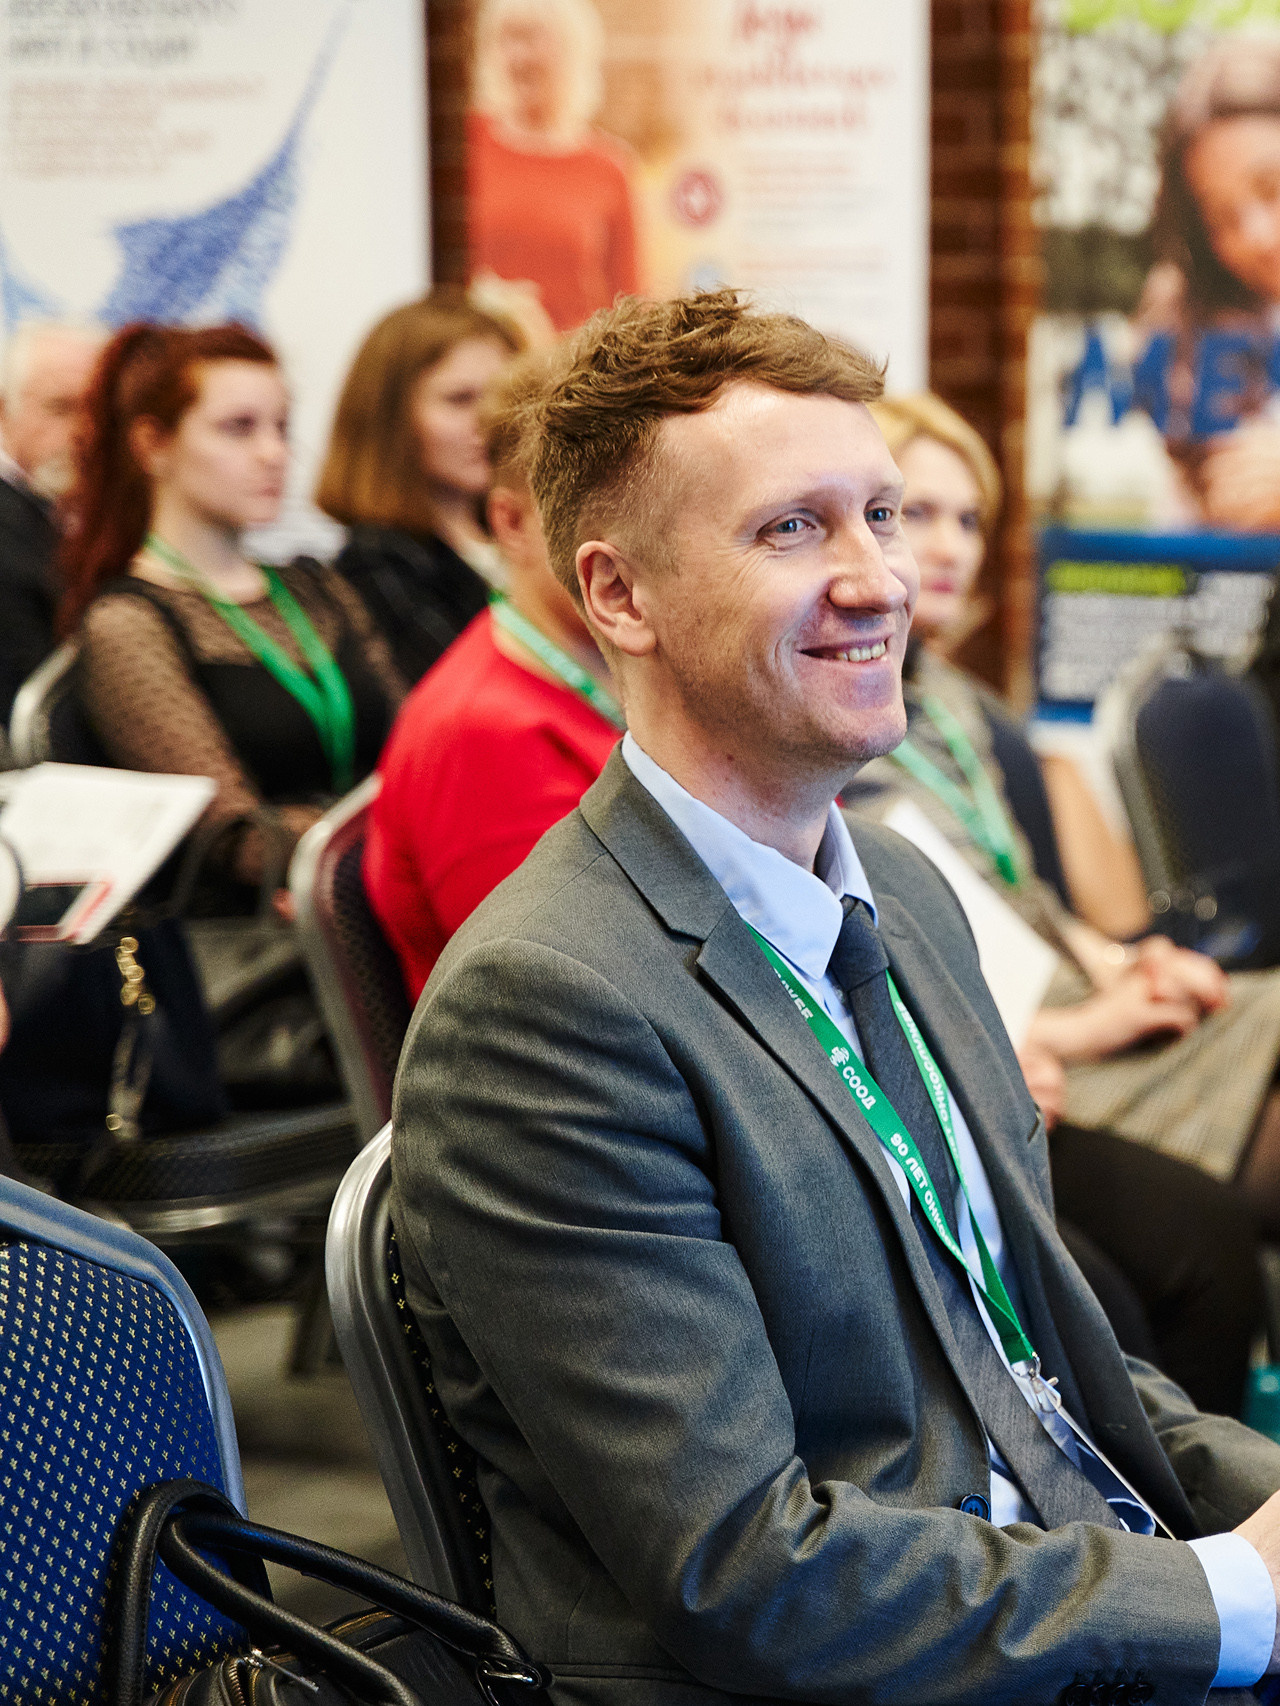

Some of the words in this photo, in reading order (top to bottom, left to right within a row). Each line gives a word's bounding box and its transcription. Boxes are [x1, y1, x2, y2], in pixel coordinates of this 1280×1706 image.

[842, 1065, 877, 1111] СООД
[890, 1132, 909, 1156] 90
[905, 1156, 929, 1190] ЛЕТ
